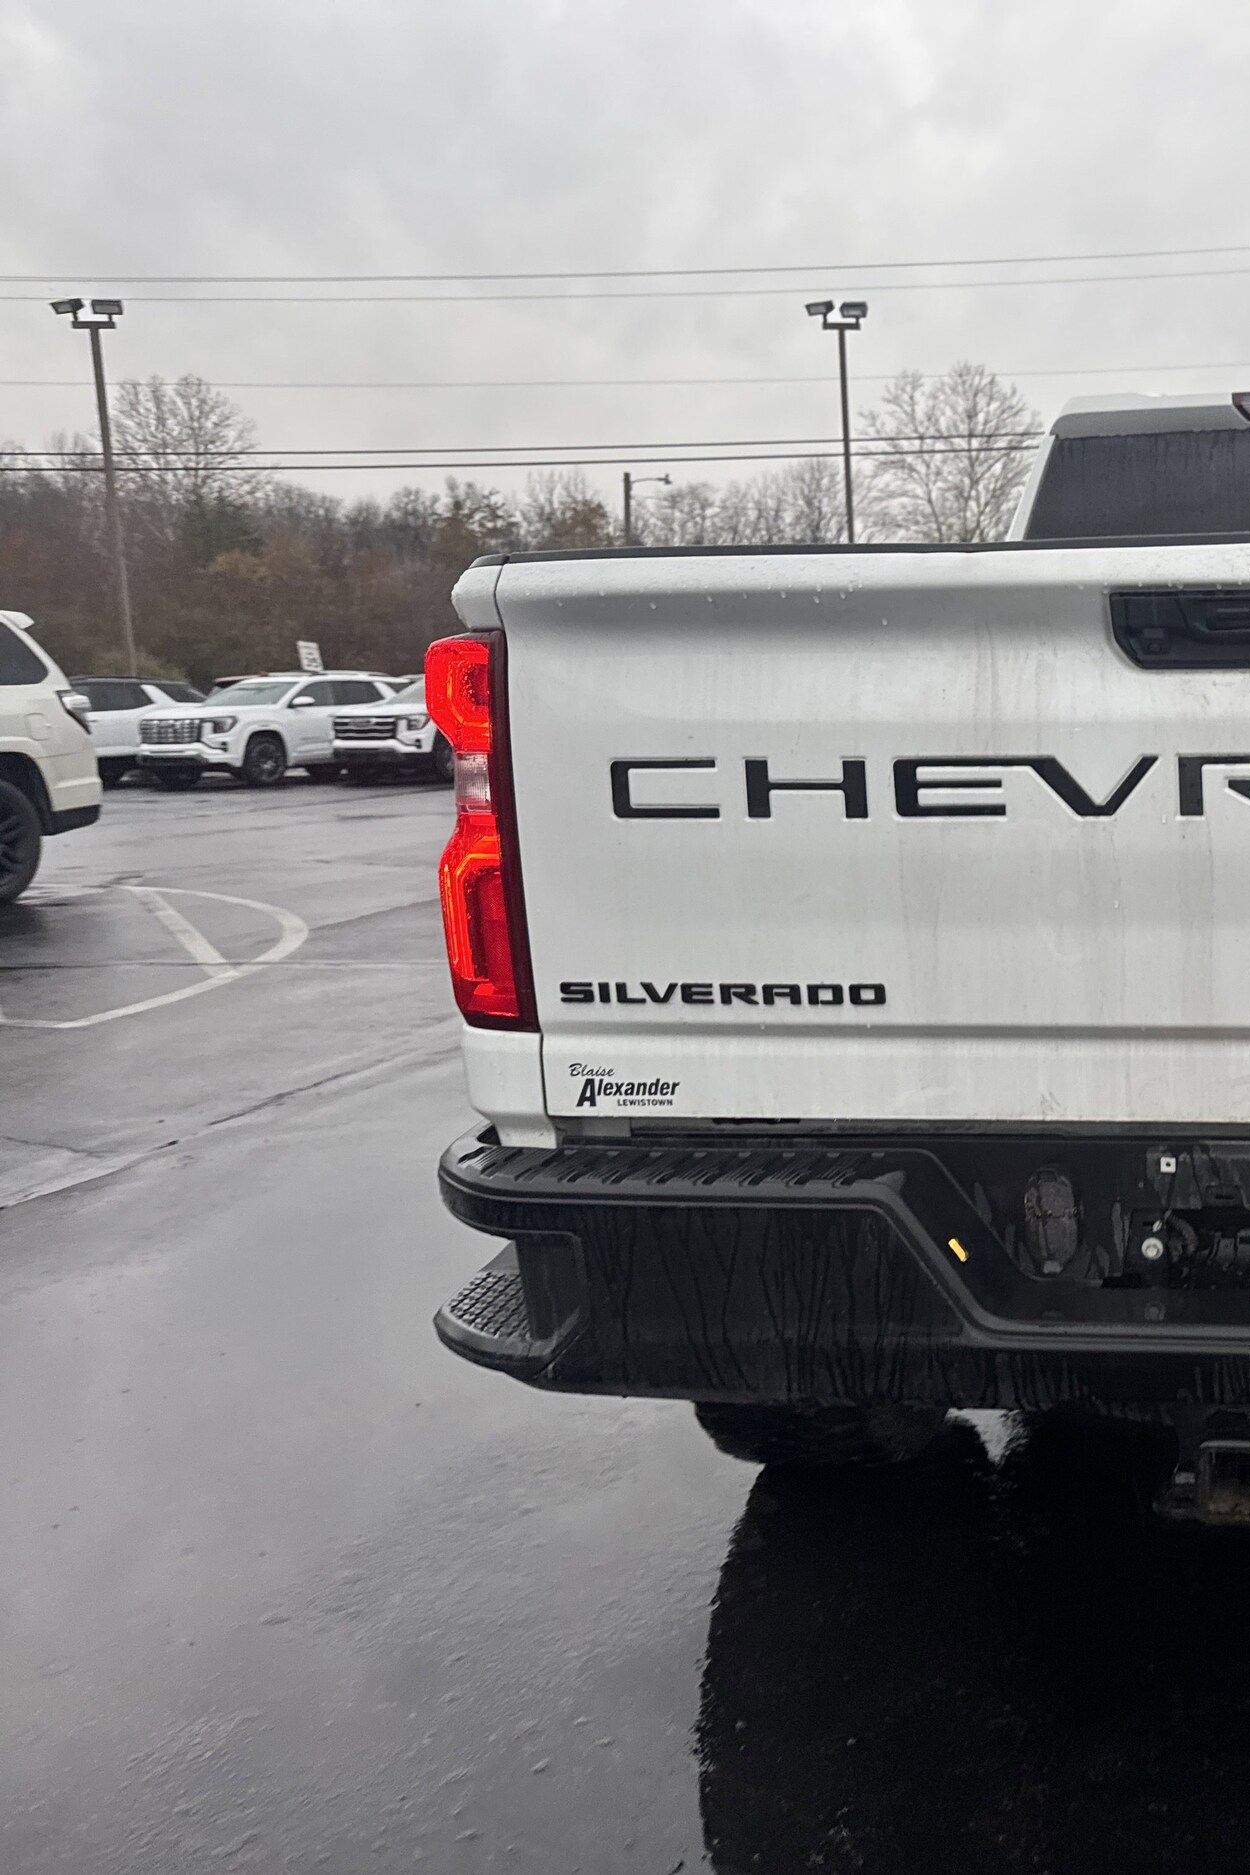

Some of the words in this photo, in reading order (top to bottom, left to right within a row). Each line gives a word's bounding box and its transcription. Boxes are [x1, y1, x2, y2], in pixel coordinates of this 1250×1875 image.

[559, 981, 887, 1006] SILVERADO
[568, 1062, 615, 1077] Blaise
[575, 1078, 680, 1107] Alexander
[617, 1098, 673, 1107] LEWISTOWN
